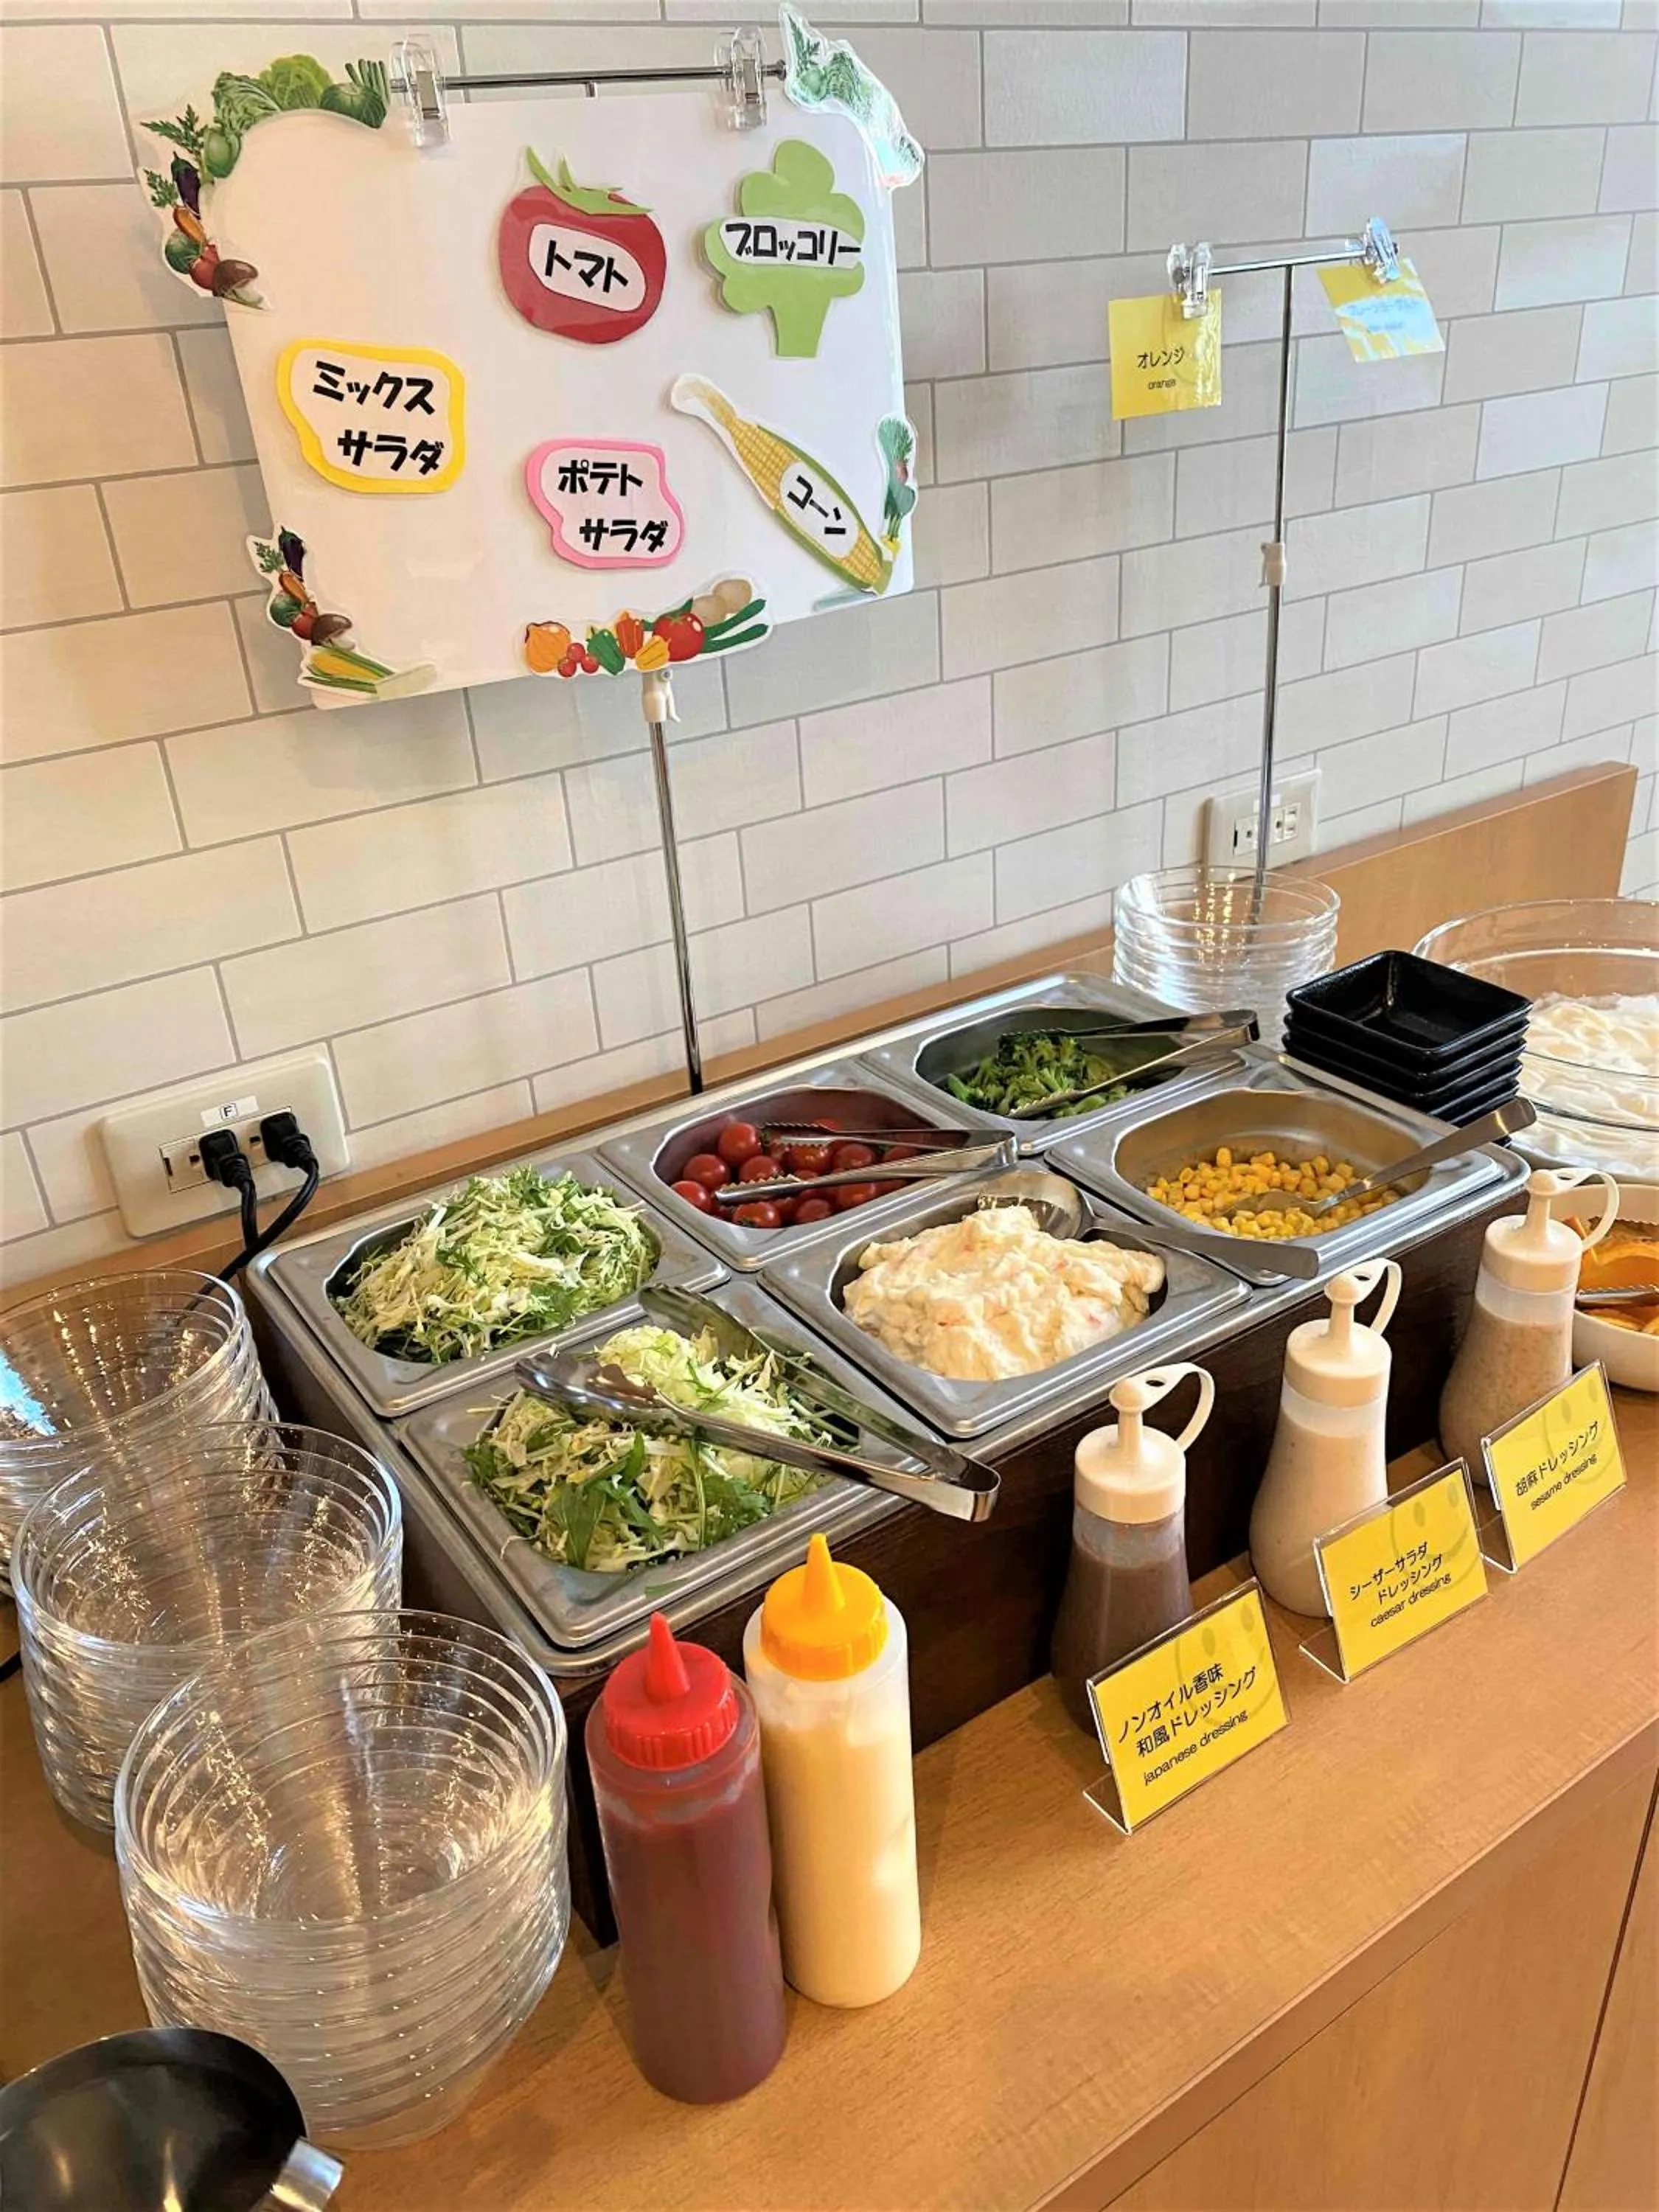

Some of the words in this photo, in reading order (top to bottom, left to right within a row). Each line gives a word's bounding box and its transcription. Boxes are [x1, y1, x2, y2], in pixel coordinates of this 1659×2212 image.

[545, 240, 629, 293] トマト
[725, 223, 861, 265] ブロッコリー
[1138, 347, 1186, 369] オレンジ
[313, 361, 435, 415] ミックス
[337, 429, 444, 476] サラダ
[557, 459, 643, 496] ポテト
[787, 475, 846, 535] コーン
[580, 518, 668, 552] サラダ
[1515, 1421, 1598, 1496] 胡麻ドレッシング
[1349, 1541, 1427, 1601] シーザーサラダ
[1378, 1554, 1442, 1604] ドレッシング
[1408, 1573, 1452, 1604] dressing
[1119, 1663, 1224, 1743] ノンオイル香味
[1136, 1666, 1256, 1757] 和風ドレッシング
[1144, 1743, 1197, 1786] japanese
[1200, 1710, 1248, 1747] dressing
